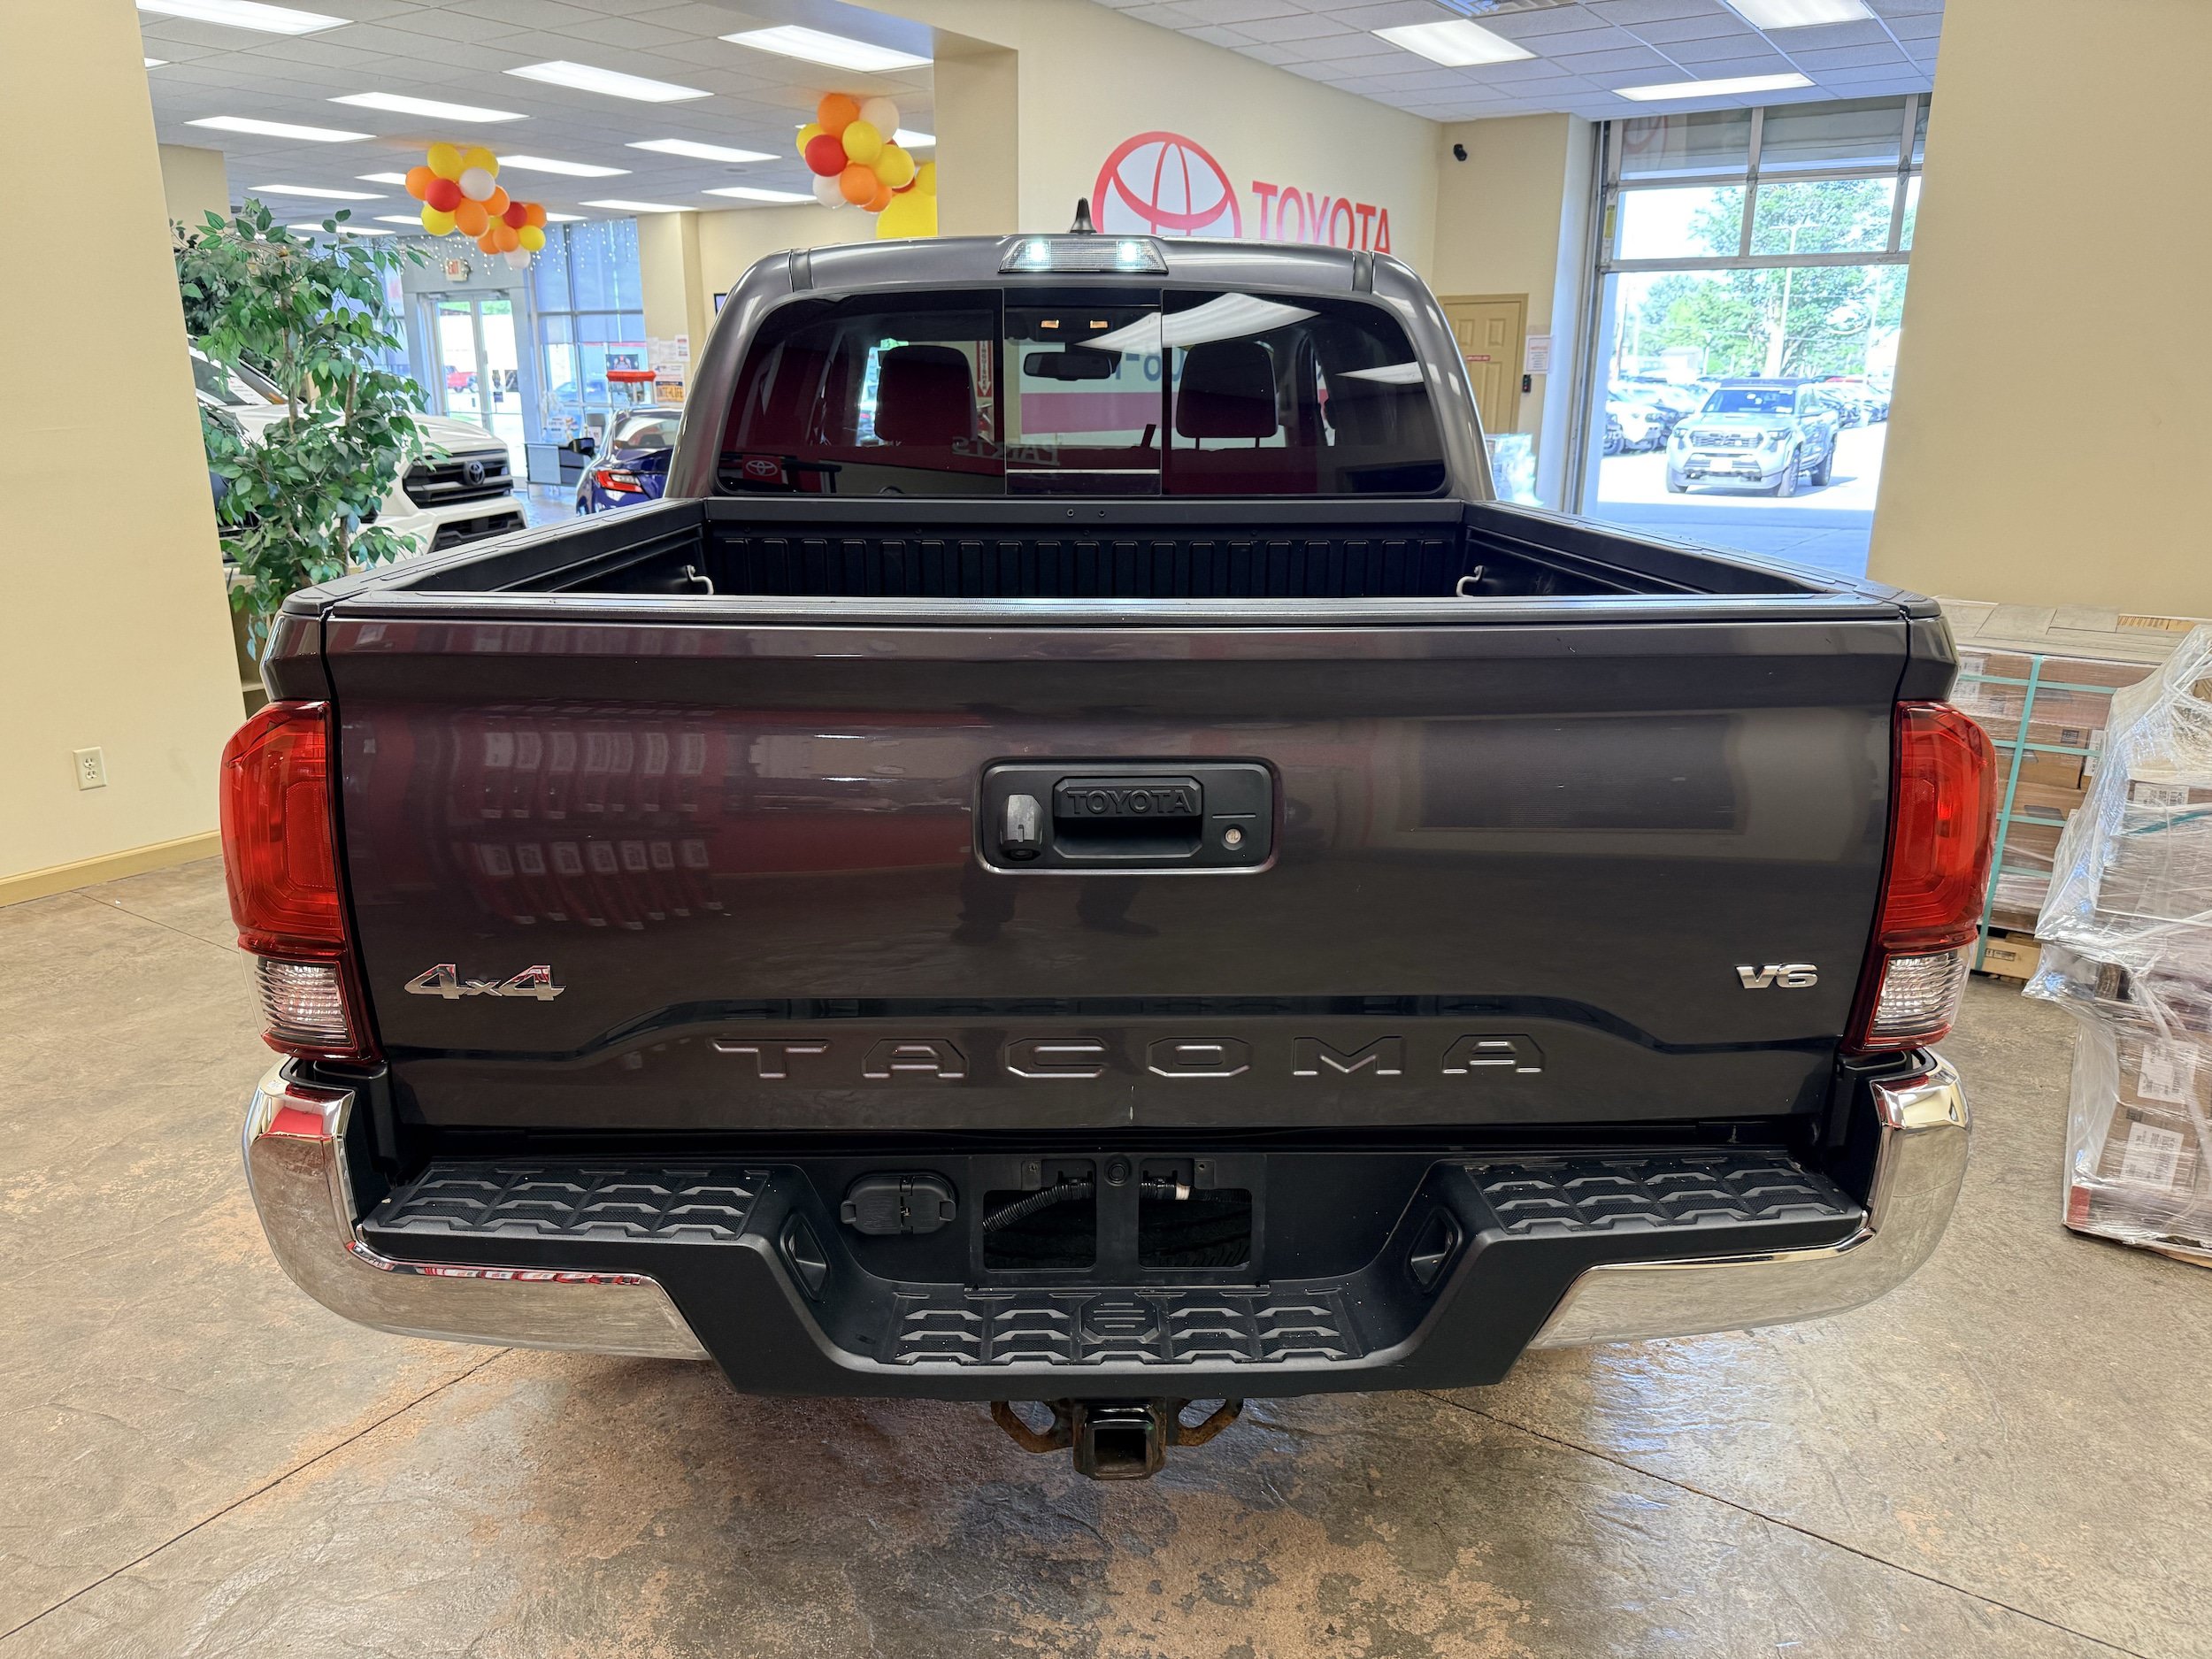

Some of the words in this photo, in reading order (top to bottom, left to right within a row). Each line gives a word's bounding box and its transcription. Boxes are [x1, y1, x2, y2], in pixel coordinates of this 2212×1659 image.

[1252, 180, 1391, 255] TOYOTA
[1066, 788, 1193, 815] TOYOTA
[404, 964, 566, 1001] 4x4
[1736, 964, 1818, 989] V6
[712, 1033, 1545, 1079] TACOMA
